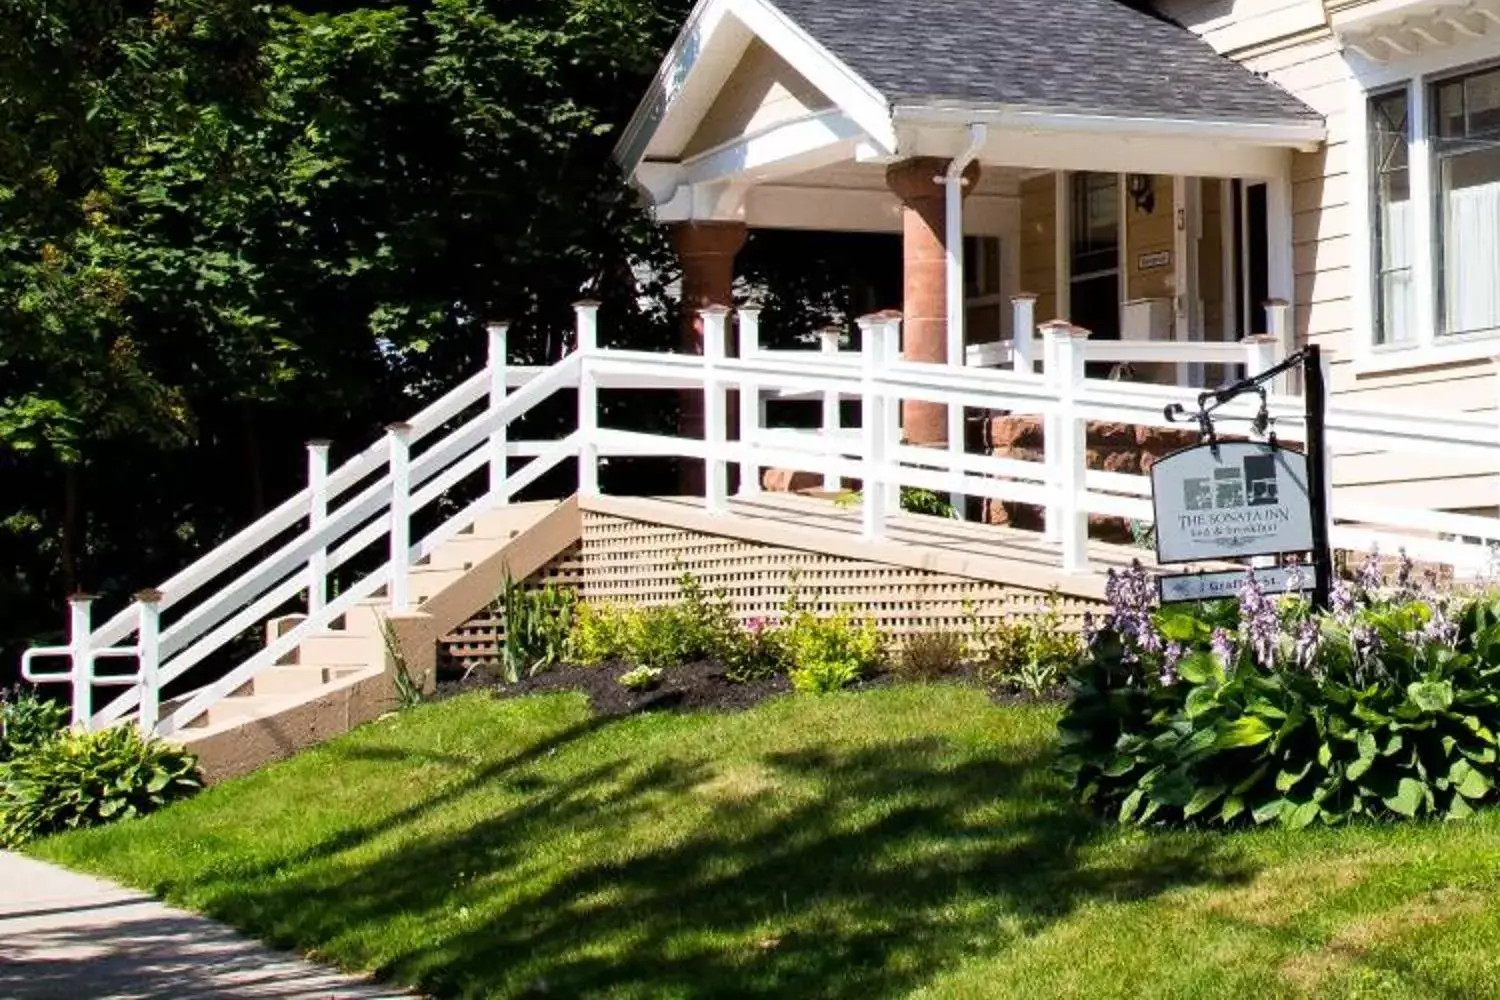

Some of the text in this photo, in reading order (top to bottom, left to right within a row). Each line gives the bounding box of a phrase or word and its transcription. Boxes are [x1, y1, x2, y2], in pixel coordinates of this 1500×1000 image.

[1178, 506, 1289, 530] THE SONATA INN
